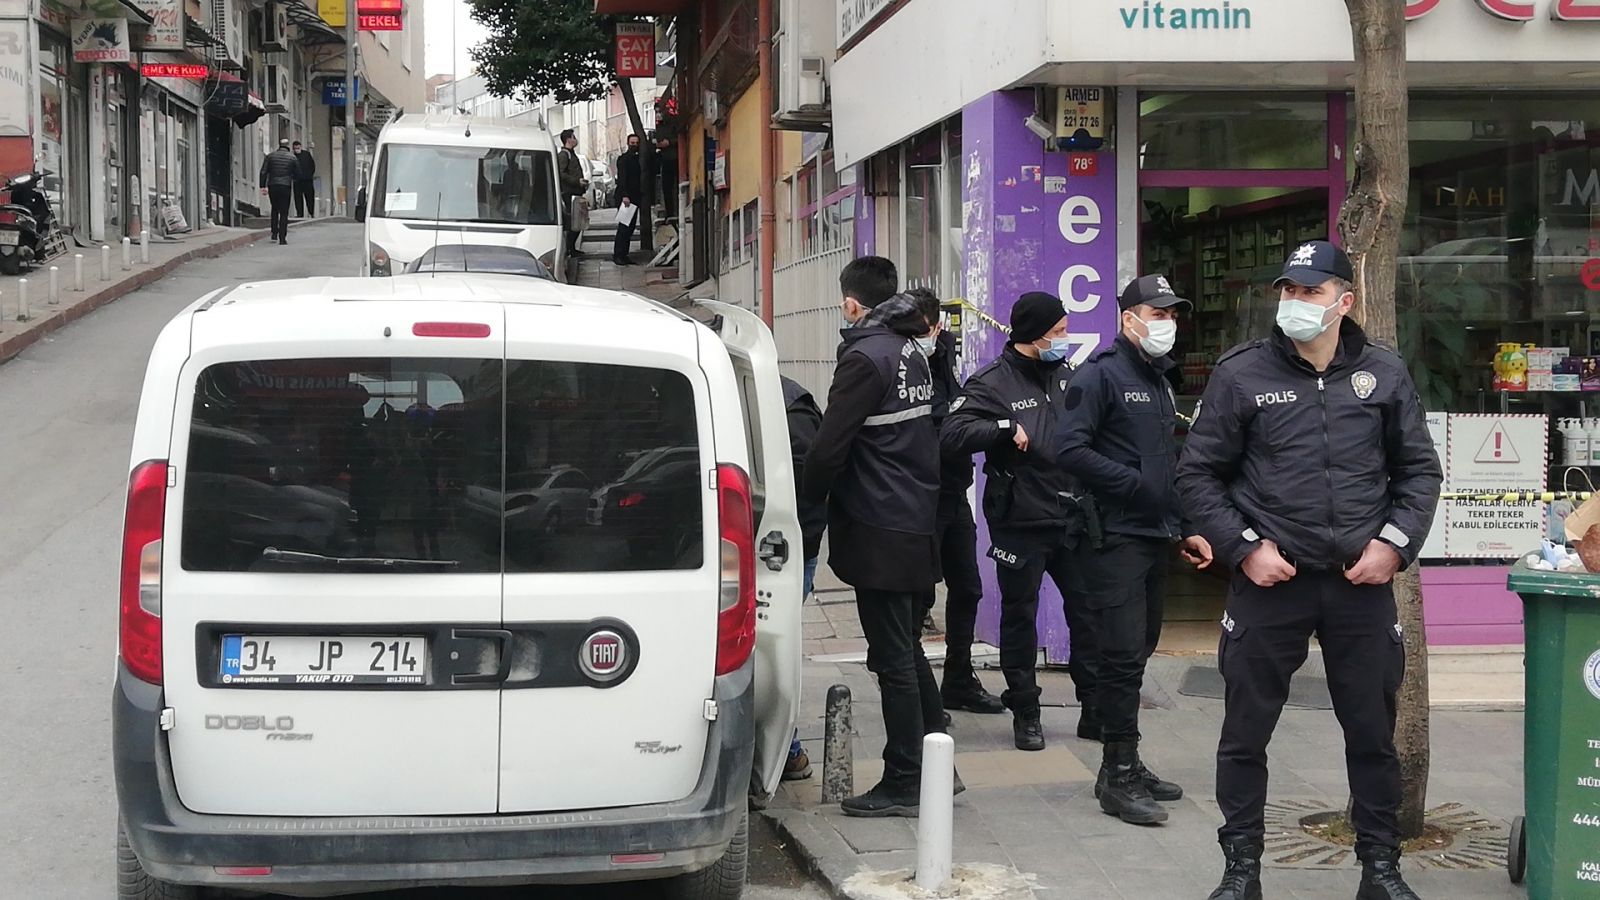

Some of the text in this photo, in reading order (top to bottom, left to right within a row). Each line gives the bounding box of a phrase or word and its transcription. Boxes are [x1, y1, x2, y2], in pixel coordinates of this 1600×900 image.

[360, 16, 399, 27] TEKEL
[1119, 1, 1251, 29] vitamin
[618, 38, 652, 55] ÇAY
[622, 53, 649, 70] EVİ
[1065, 88, 1099, 101] ARMED
[1064, 116, 1099, 127] 221 27 26
[897, 360, 908, 399] OLAY
[1456, 499, 1500, 507] HASTALAR
[1468, 510, 1524, 518] TEKER TEKER
[1452, 519, 1539, 530] KABUL EDİLECEKTİR
[226, 641, 416, 672] TR 34 JP 214
[593, 643, 617, 664] FIAT
[295, 675, 330, 683] YAKUP
[333, 675, 354, 683] OTO
[205, 714, 294, 730] DOBLO
[1573, 813, 1600, 827] 444
